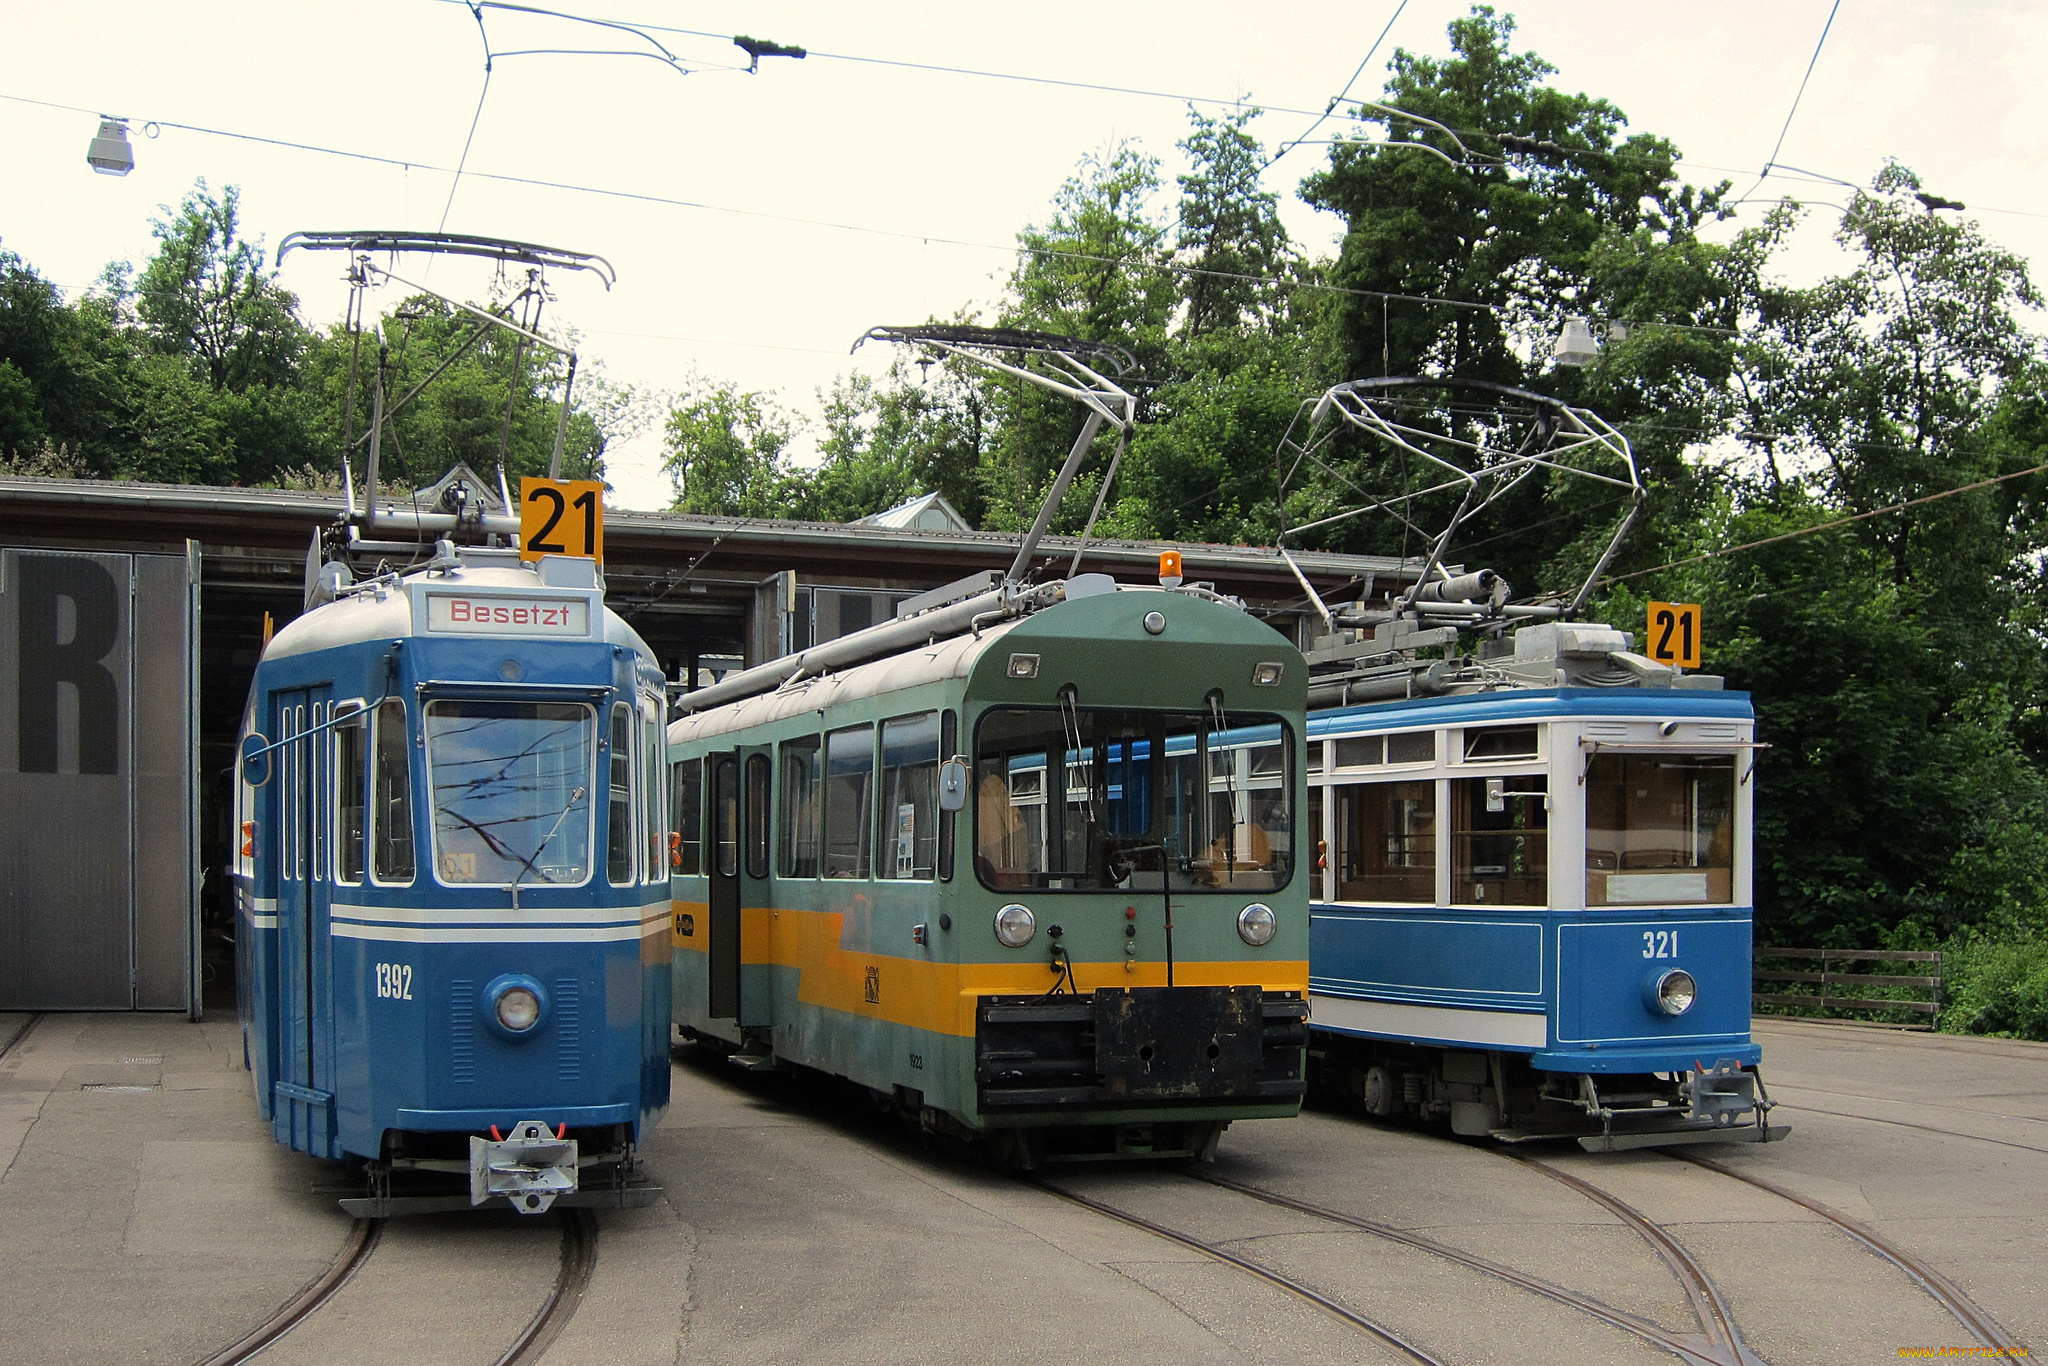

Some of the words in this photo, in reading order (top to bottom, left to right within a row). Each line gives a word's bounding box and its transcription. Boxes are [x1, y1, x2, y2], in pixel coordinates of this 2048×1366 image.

[526, 486, 596, 556] 21
[449, 600, 571, 626] Besetzt
[1655, 609, 1692, 661] 21
[1642, 930, 1678, 959] 321
[375, 963, 413, 1001] 1392
[910, 1053, 923, 1070] 1923
